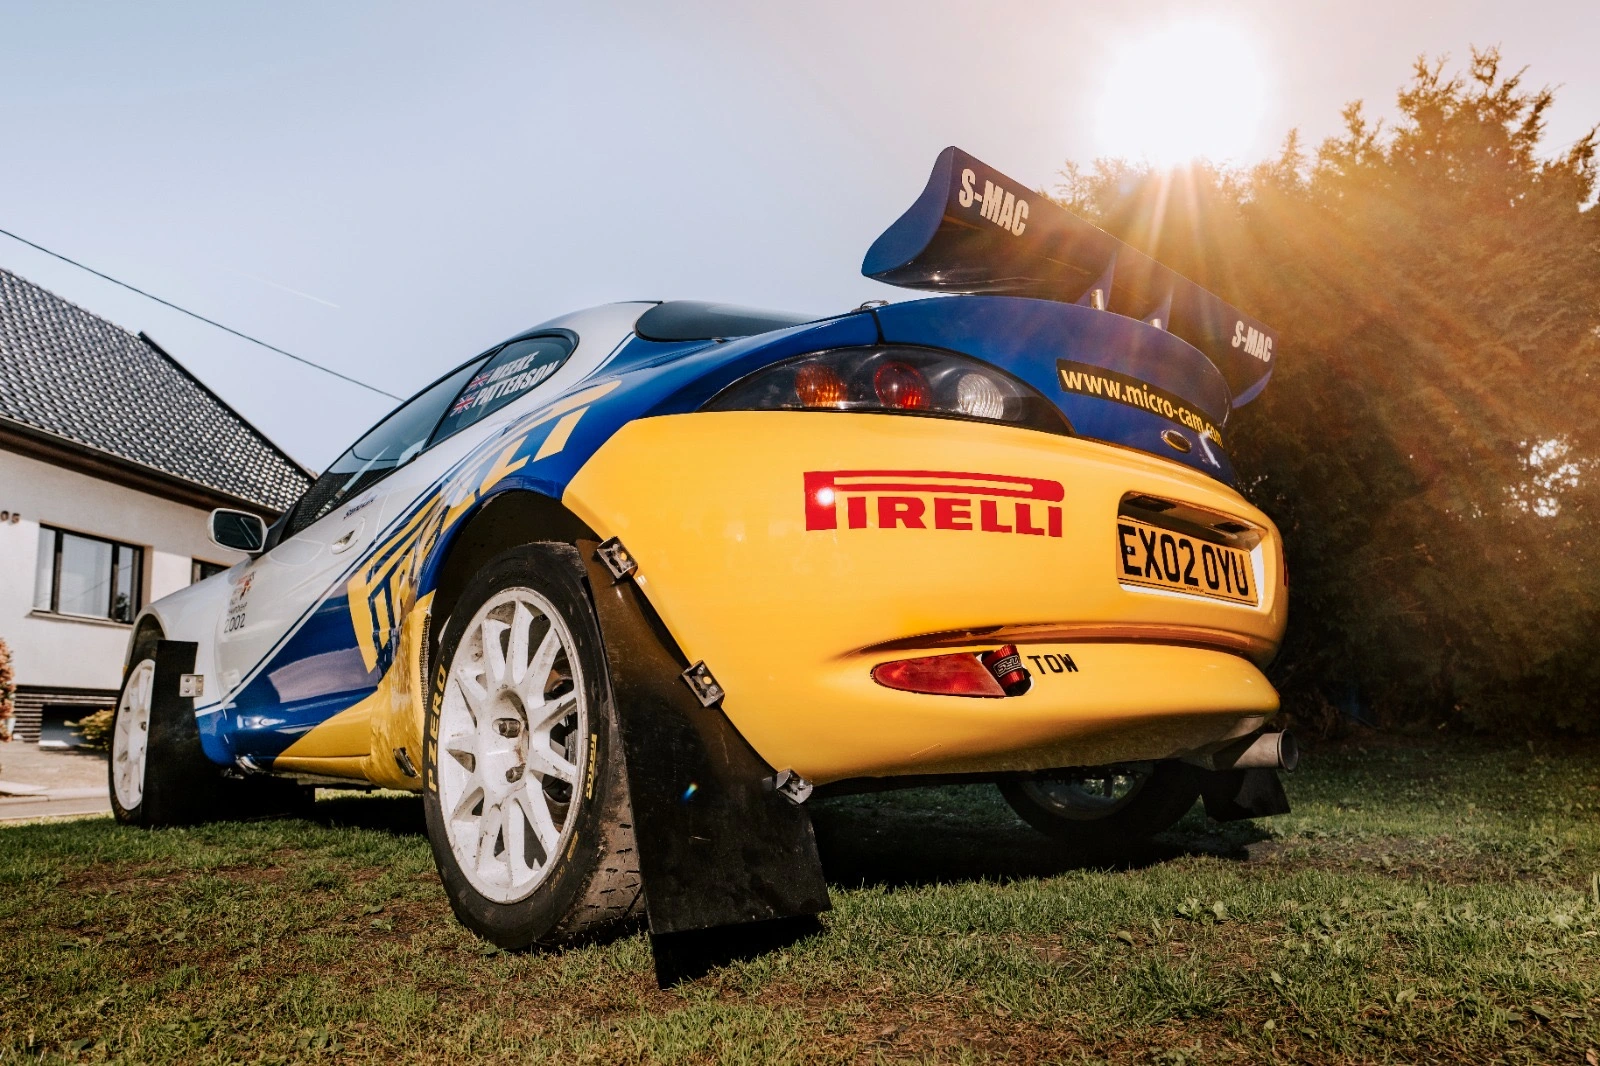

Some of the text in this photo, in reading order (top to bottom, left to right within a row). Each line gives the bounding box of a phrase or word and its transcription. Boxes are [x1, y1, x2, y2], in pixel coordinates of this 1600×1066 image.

[959, 168, 1029, 236] S-MAC
[1231, 320, 1272, 362] S-MAC
[471, 360, 560, 408] PATTERSON
[486, 351, 539, 383] MEEKE
[1061, 369, 1224, 449] www.micro-camcom
[803, 470, 1065, 538] PIRELLI
[1117, 523, 1249, 597] EX02 OYU
[224, 613, 246, 633] 2002
[1027, 653, 1079, 675] TOW
